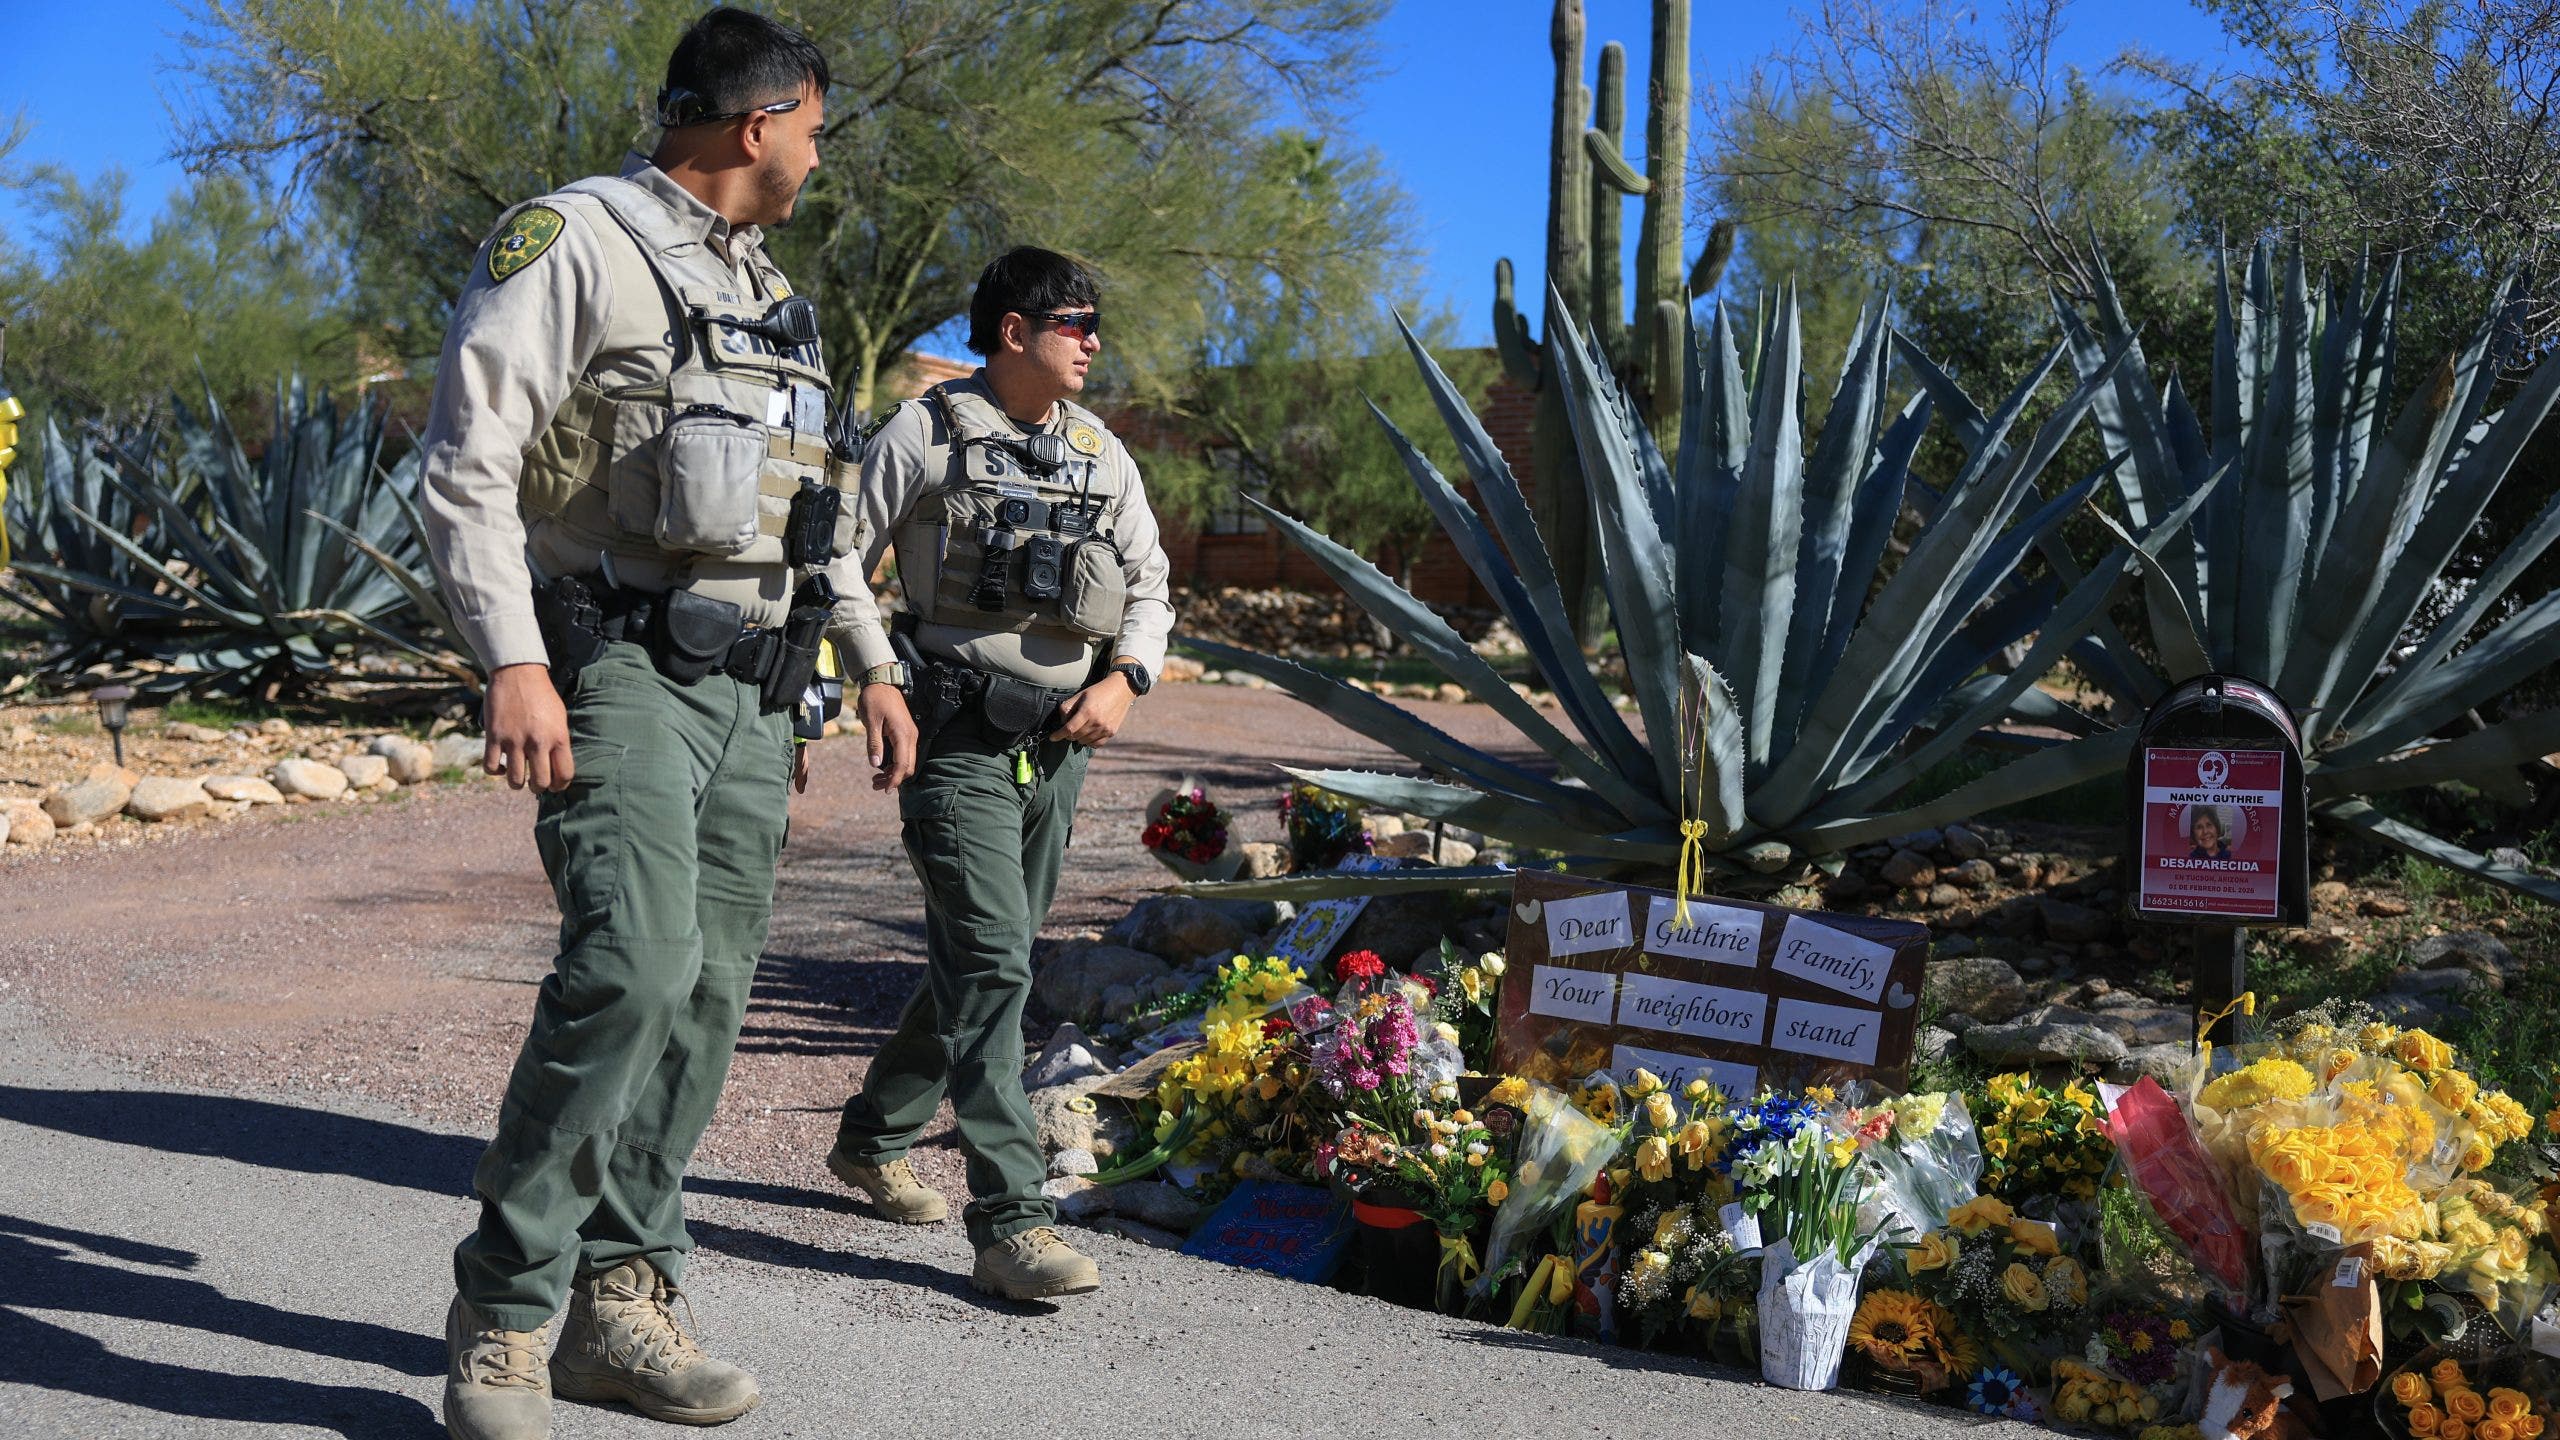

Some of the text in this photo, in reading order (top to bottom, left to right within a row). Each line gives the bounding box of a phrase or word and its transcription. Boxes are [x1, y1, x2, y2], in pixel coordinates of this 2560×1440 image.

[2170, 793, 2264, 804] NANCY GUTHRIE
[2160, 858, 2259, 872] DESAPARECIDA
[2190, 885, 2221, 893] FEBRERO
[1559, 915, 1876, 991] Dear Guthrie Family,
[1545, 977, 1866, 1049] Your neighbors stand
